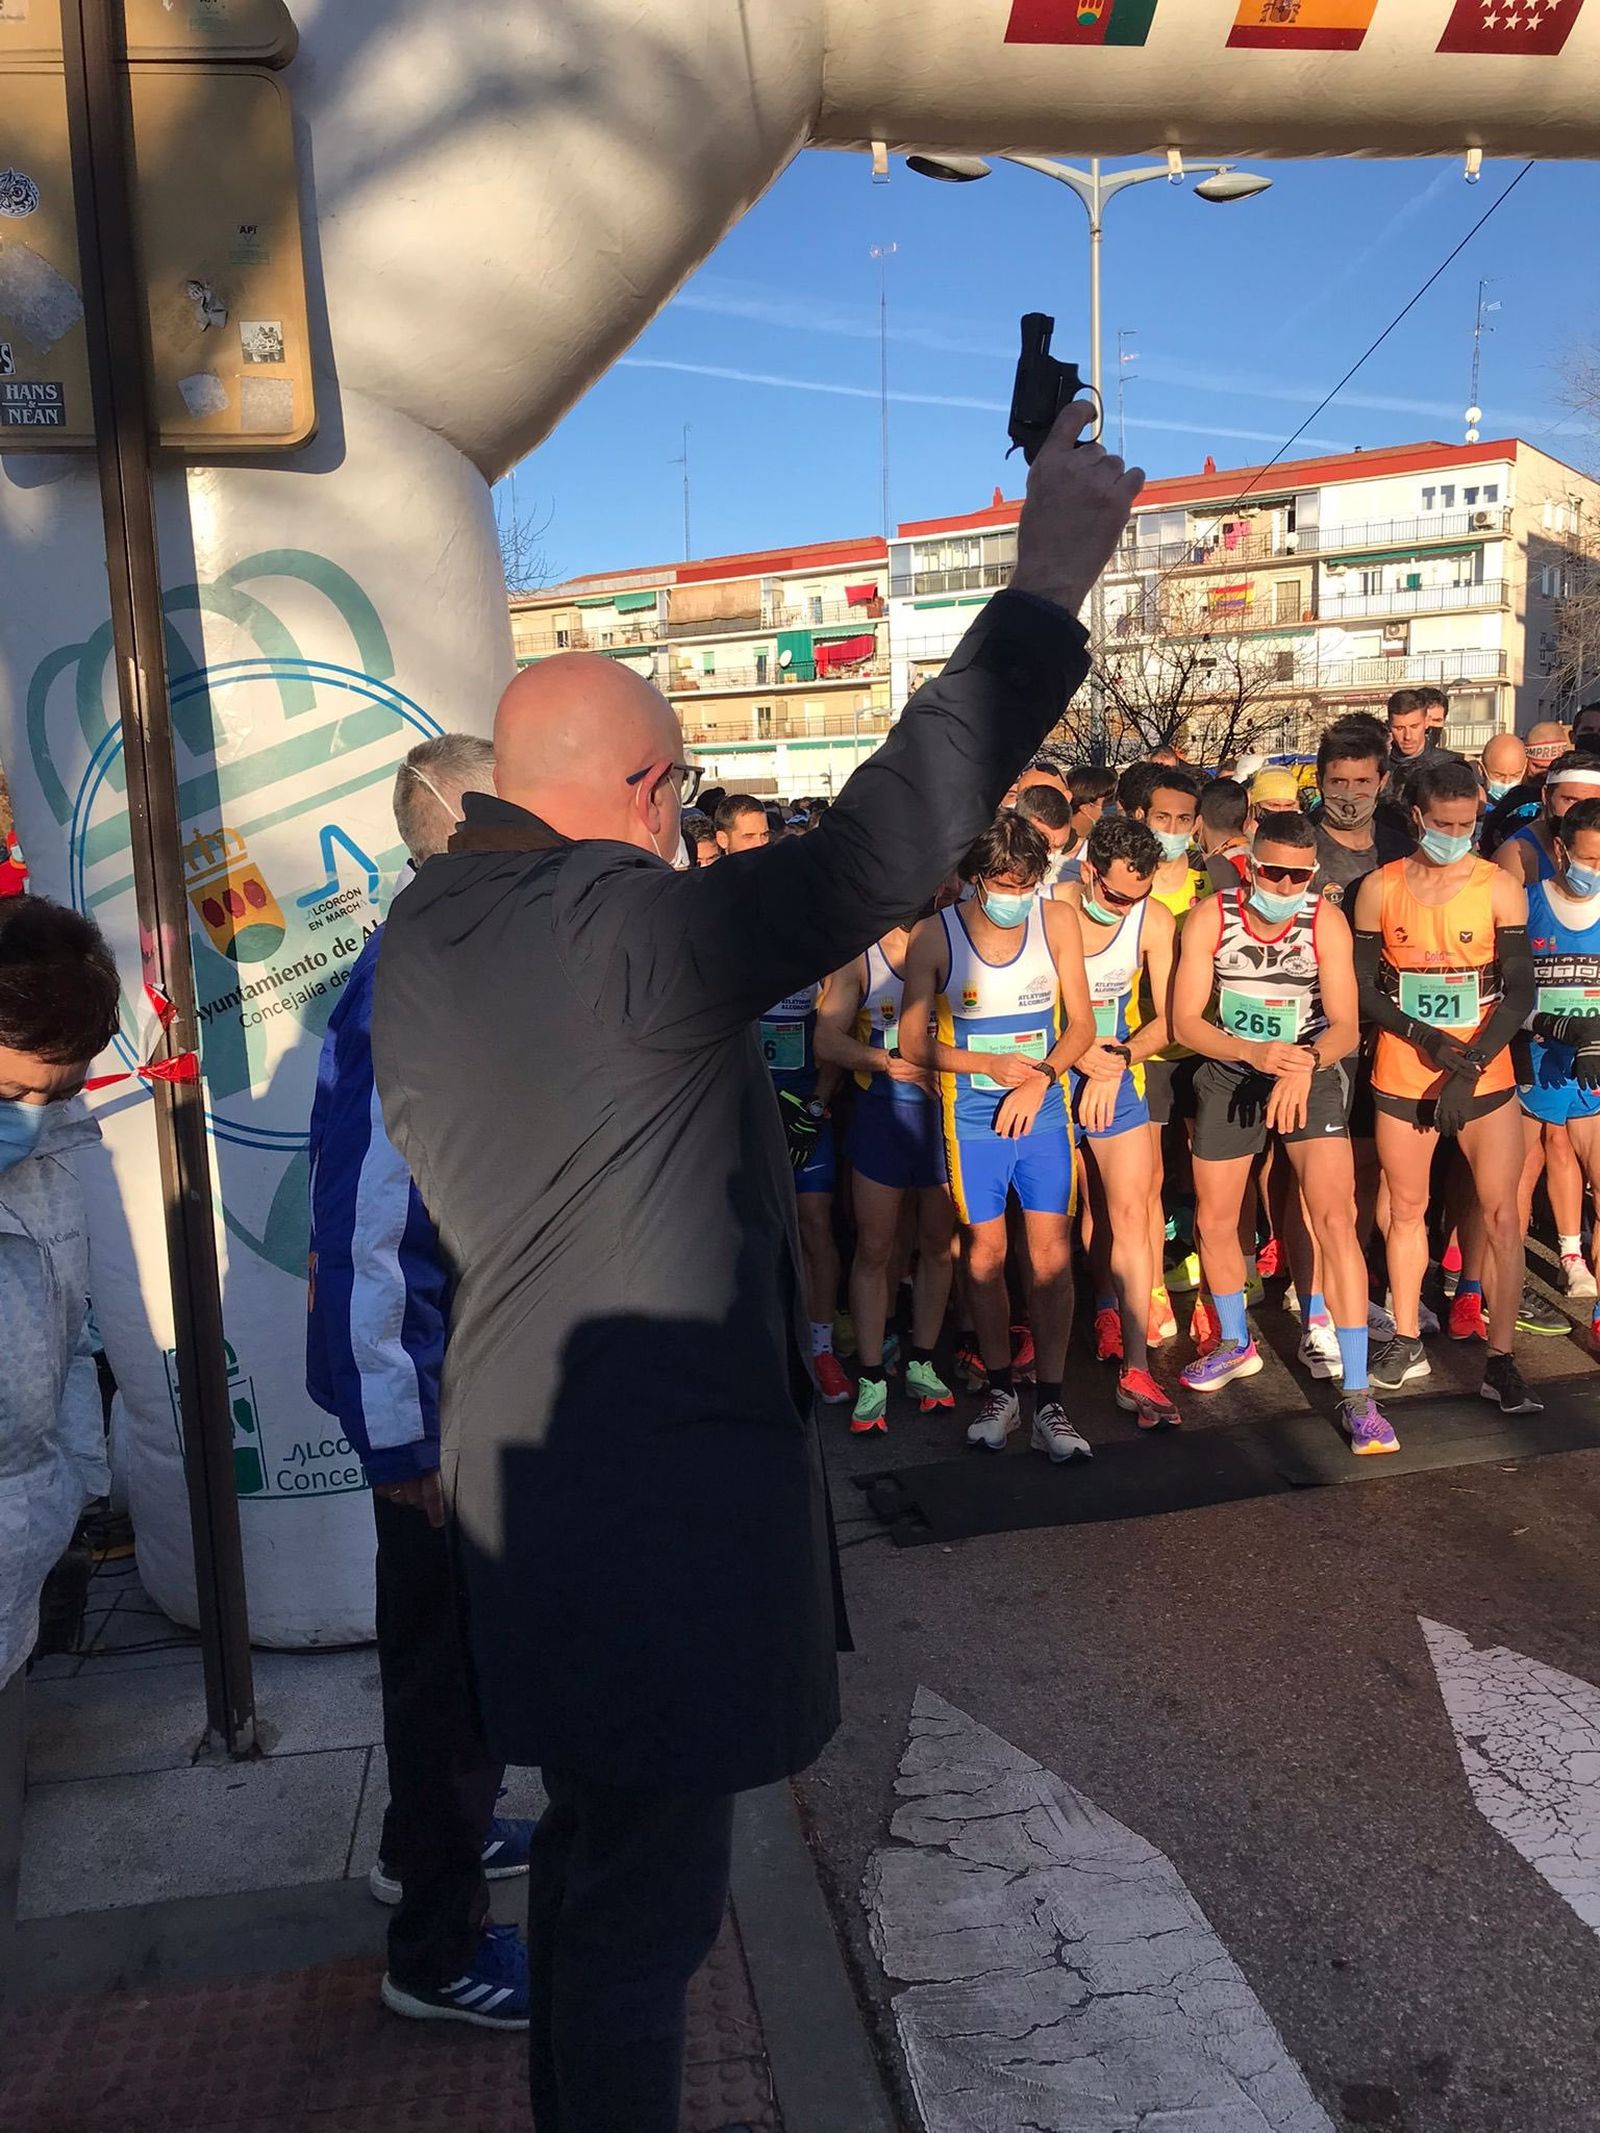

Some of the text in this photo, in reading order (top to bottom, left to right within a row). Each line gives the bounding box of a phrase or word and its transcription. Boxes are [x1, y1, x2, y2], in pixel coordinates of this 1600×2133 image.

[5, 384, 58, 400] HANS
[8, 408, 59, 424] NEAN
[308, 918, 324, 931] EN
[194, 952, 328, 1025] Ayuntamiento
[331, 936, 359, 959] de
[239, 970, 350, 1028] Concejalía de
[1418, 994, 1460, 1018] 521
[1234, 1009, 1281, 1037] 265
